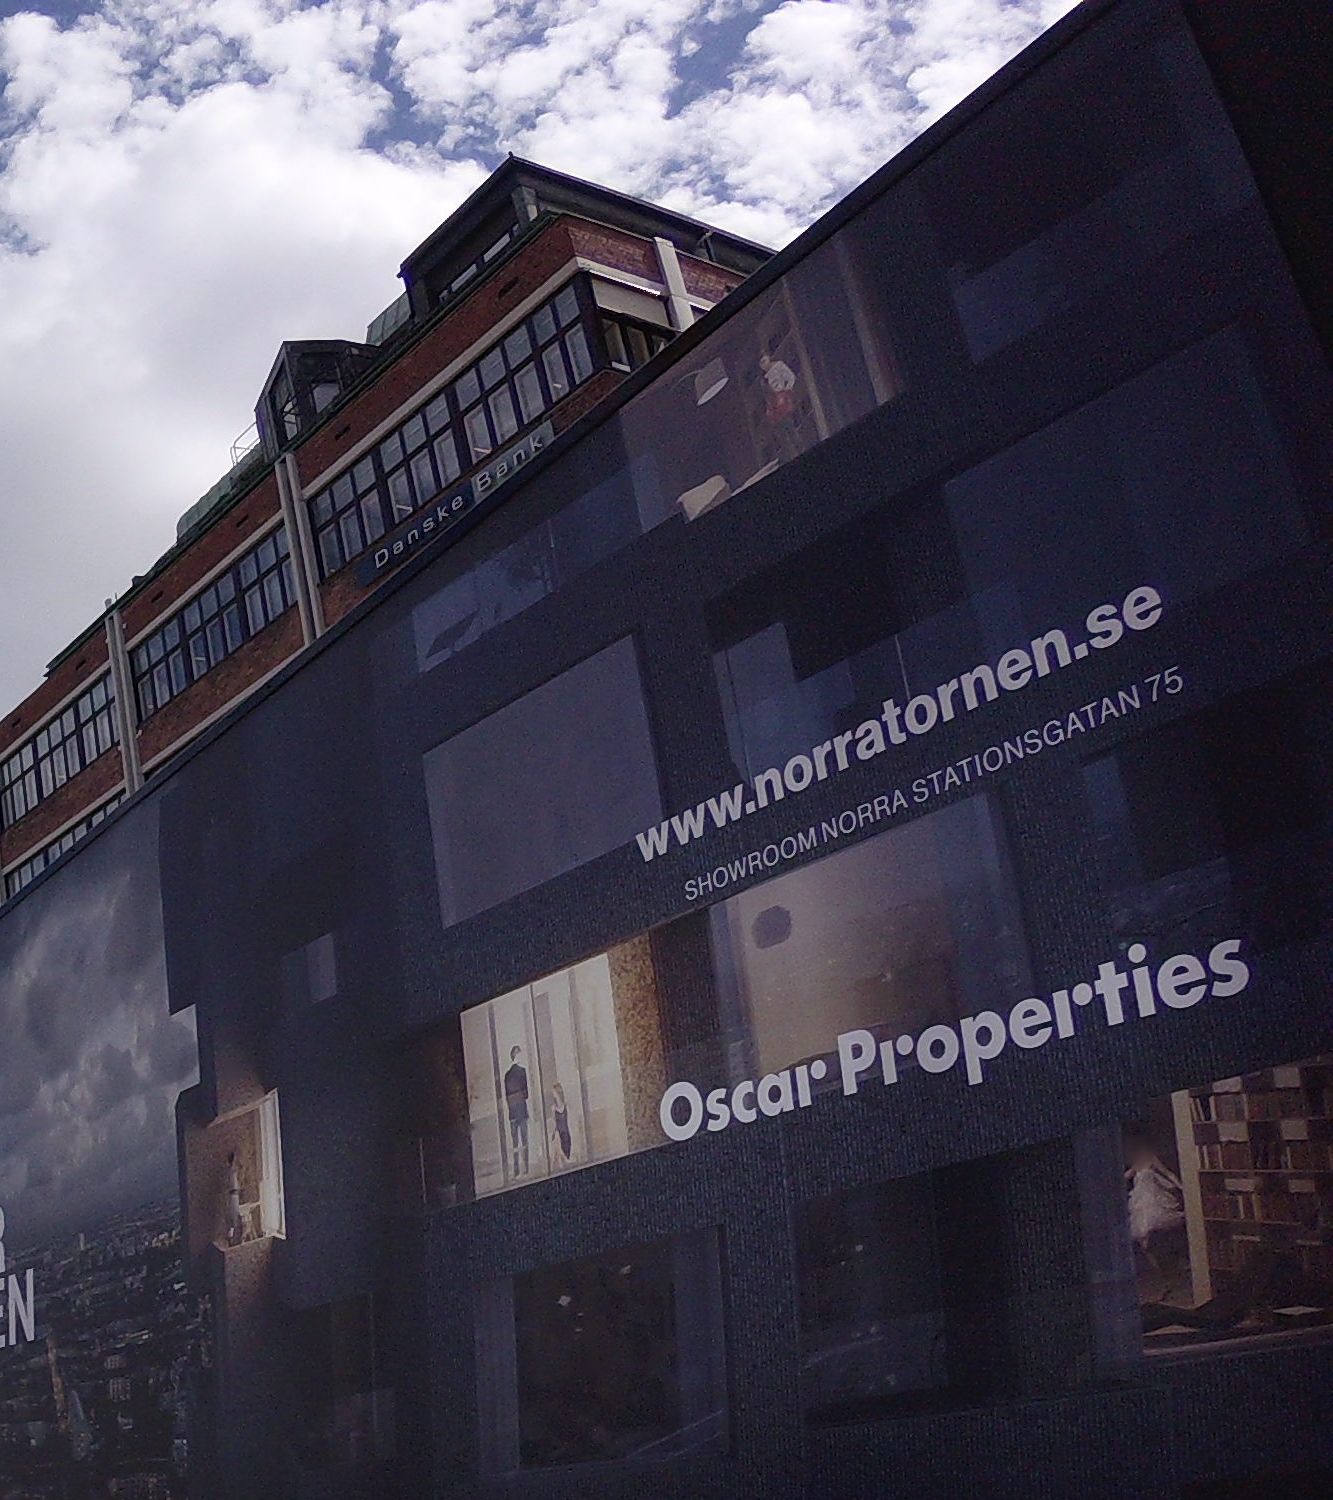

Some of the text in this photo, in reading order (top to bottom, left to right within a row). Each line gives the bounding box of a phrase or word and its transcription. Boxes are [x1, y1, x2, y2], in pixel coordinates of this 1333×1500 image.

[373, 435, 544, 570] Danske Bank
[635, 584, 1164, 862] www.norratornen.se
[683, 666, 1185, 901] SHOWROOM NORRA STATIONSGATAN 75
[659, 937, 1251, 1141] Oscar Properties
